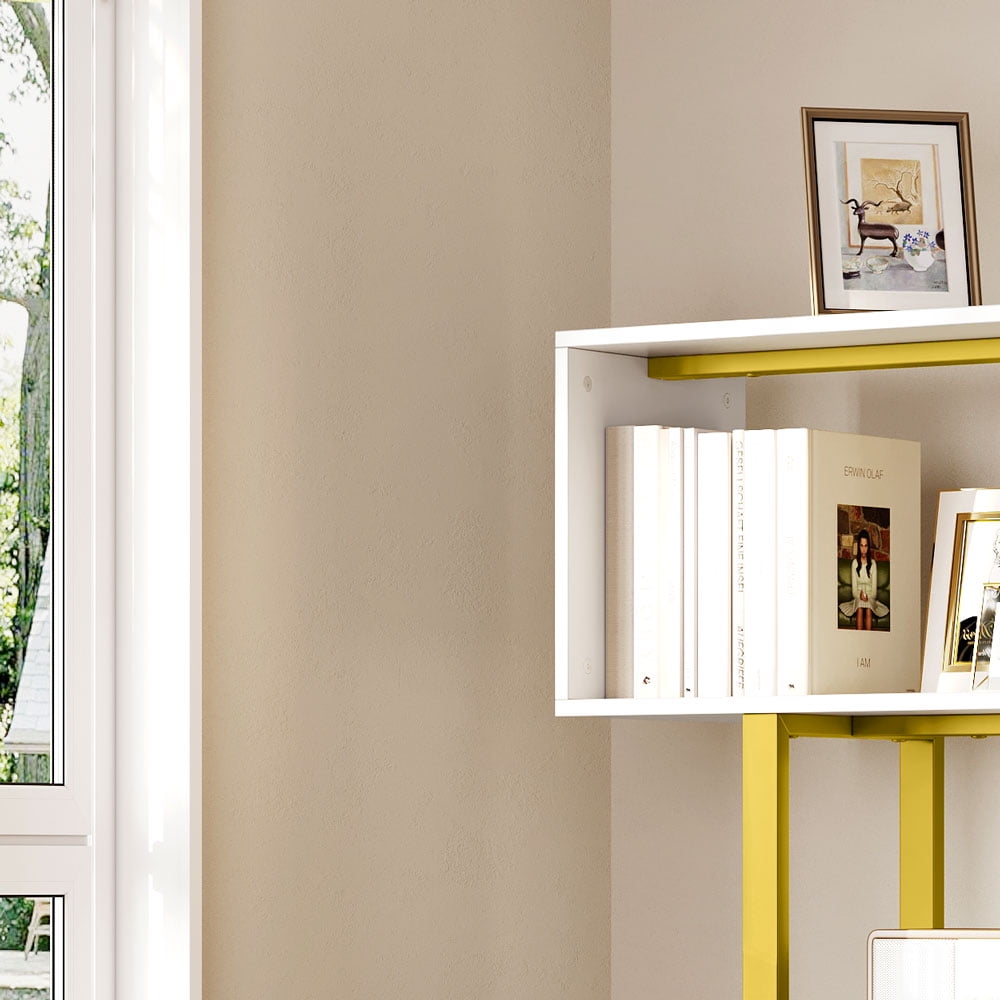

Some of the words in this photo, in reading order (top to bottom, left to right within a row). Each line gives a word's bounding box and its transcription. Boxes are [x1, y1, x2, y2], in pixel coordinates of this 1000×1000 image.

[843, 465, 866, 479] ERWIN
[866, 467, 885, 480] OLAF
[859, 657, 872, 669] AM
